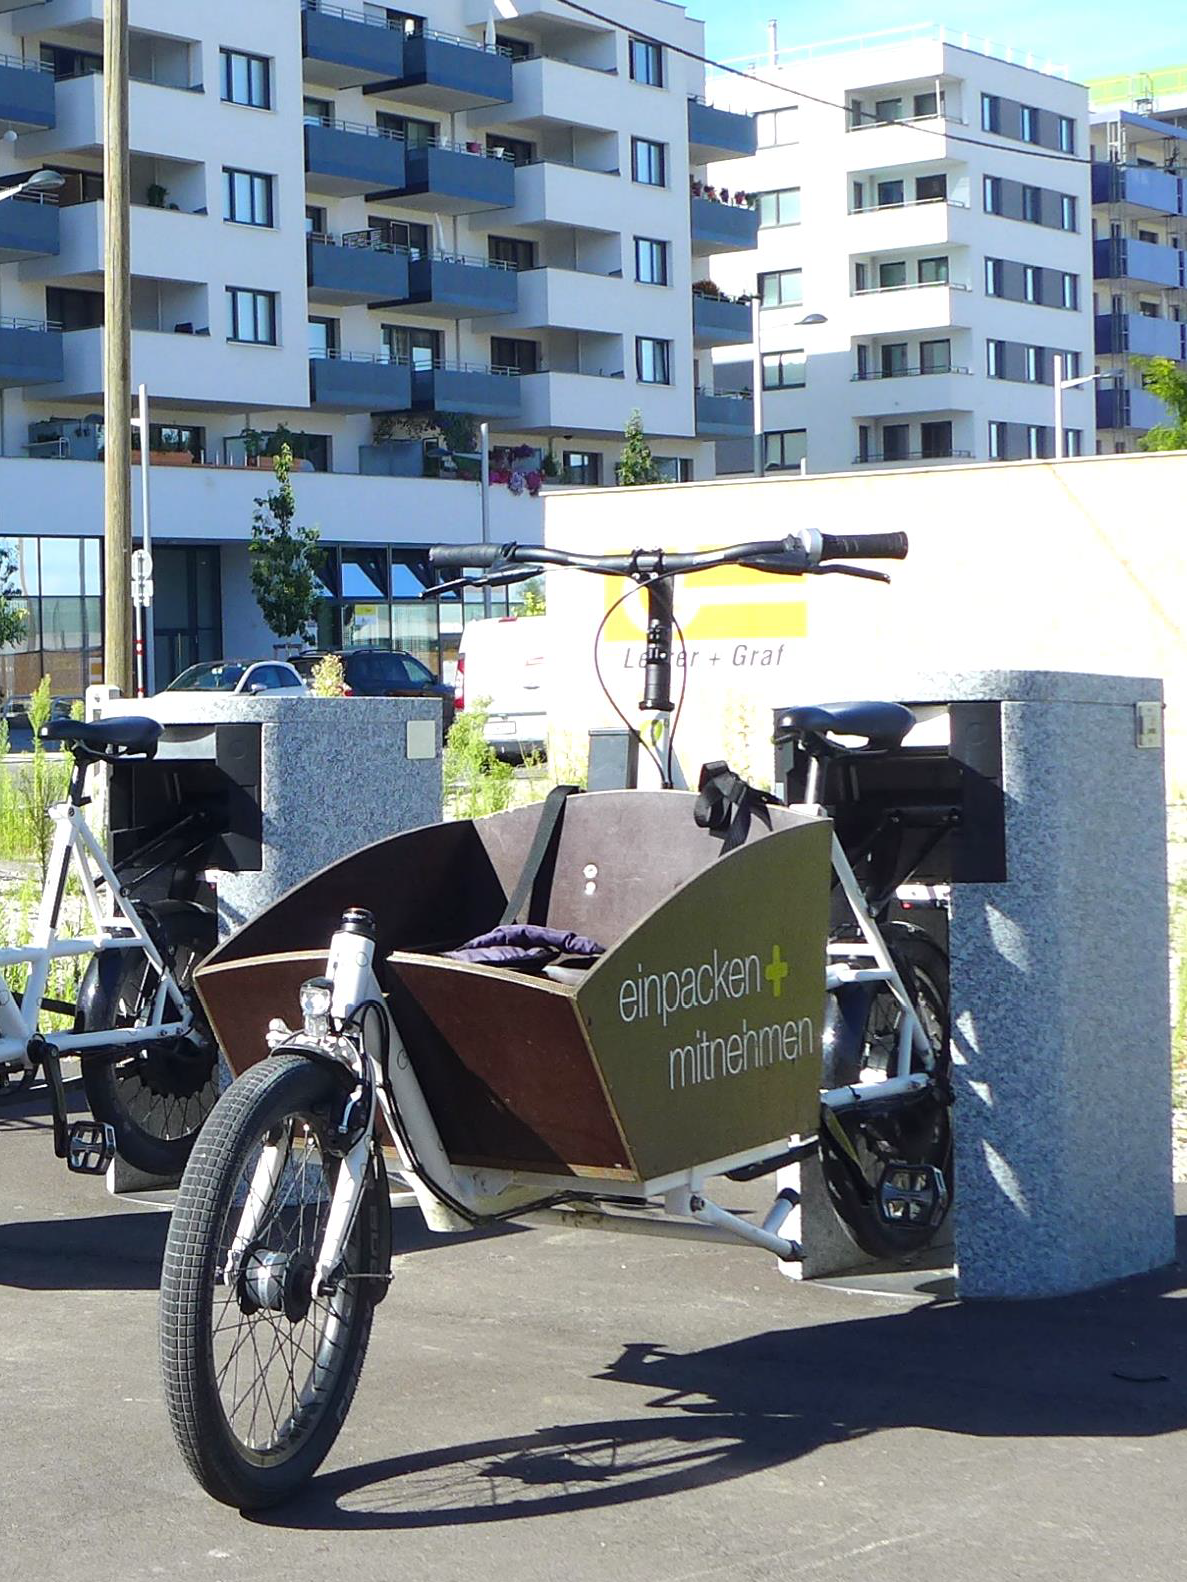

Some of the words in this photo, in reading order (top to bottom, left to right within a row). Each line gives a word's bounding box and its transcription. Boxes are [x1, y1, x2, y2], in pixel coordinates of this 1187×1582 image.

[623, 647, 699, 668] Leer
[709, 652, 721, 666] +
[732, 643, 784, 666] Graf
[619, 948, 761, 1027] einpacken
[669, 1017, 813, 1090] mitnehmen
